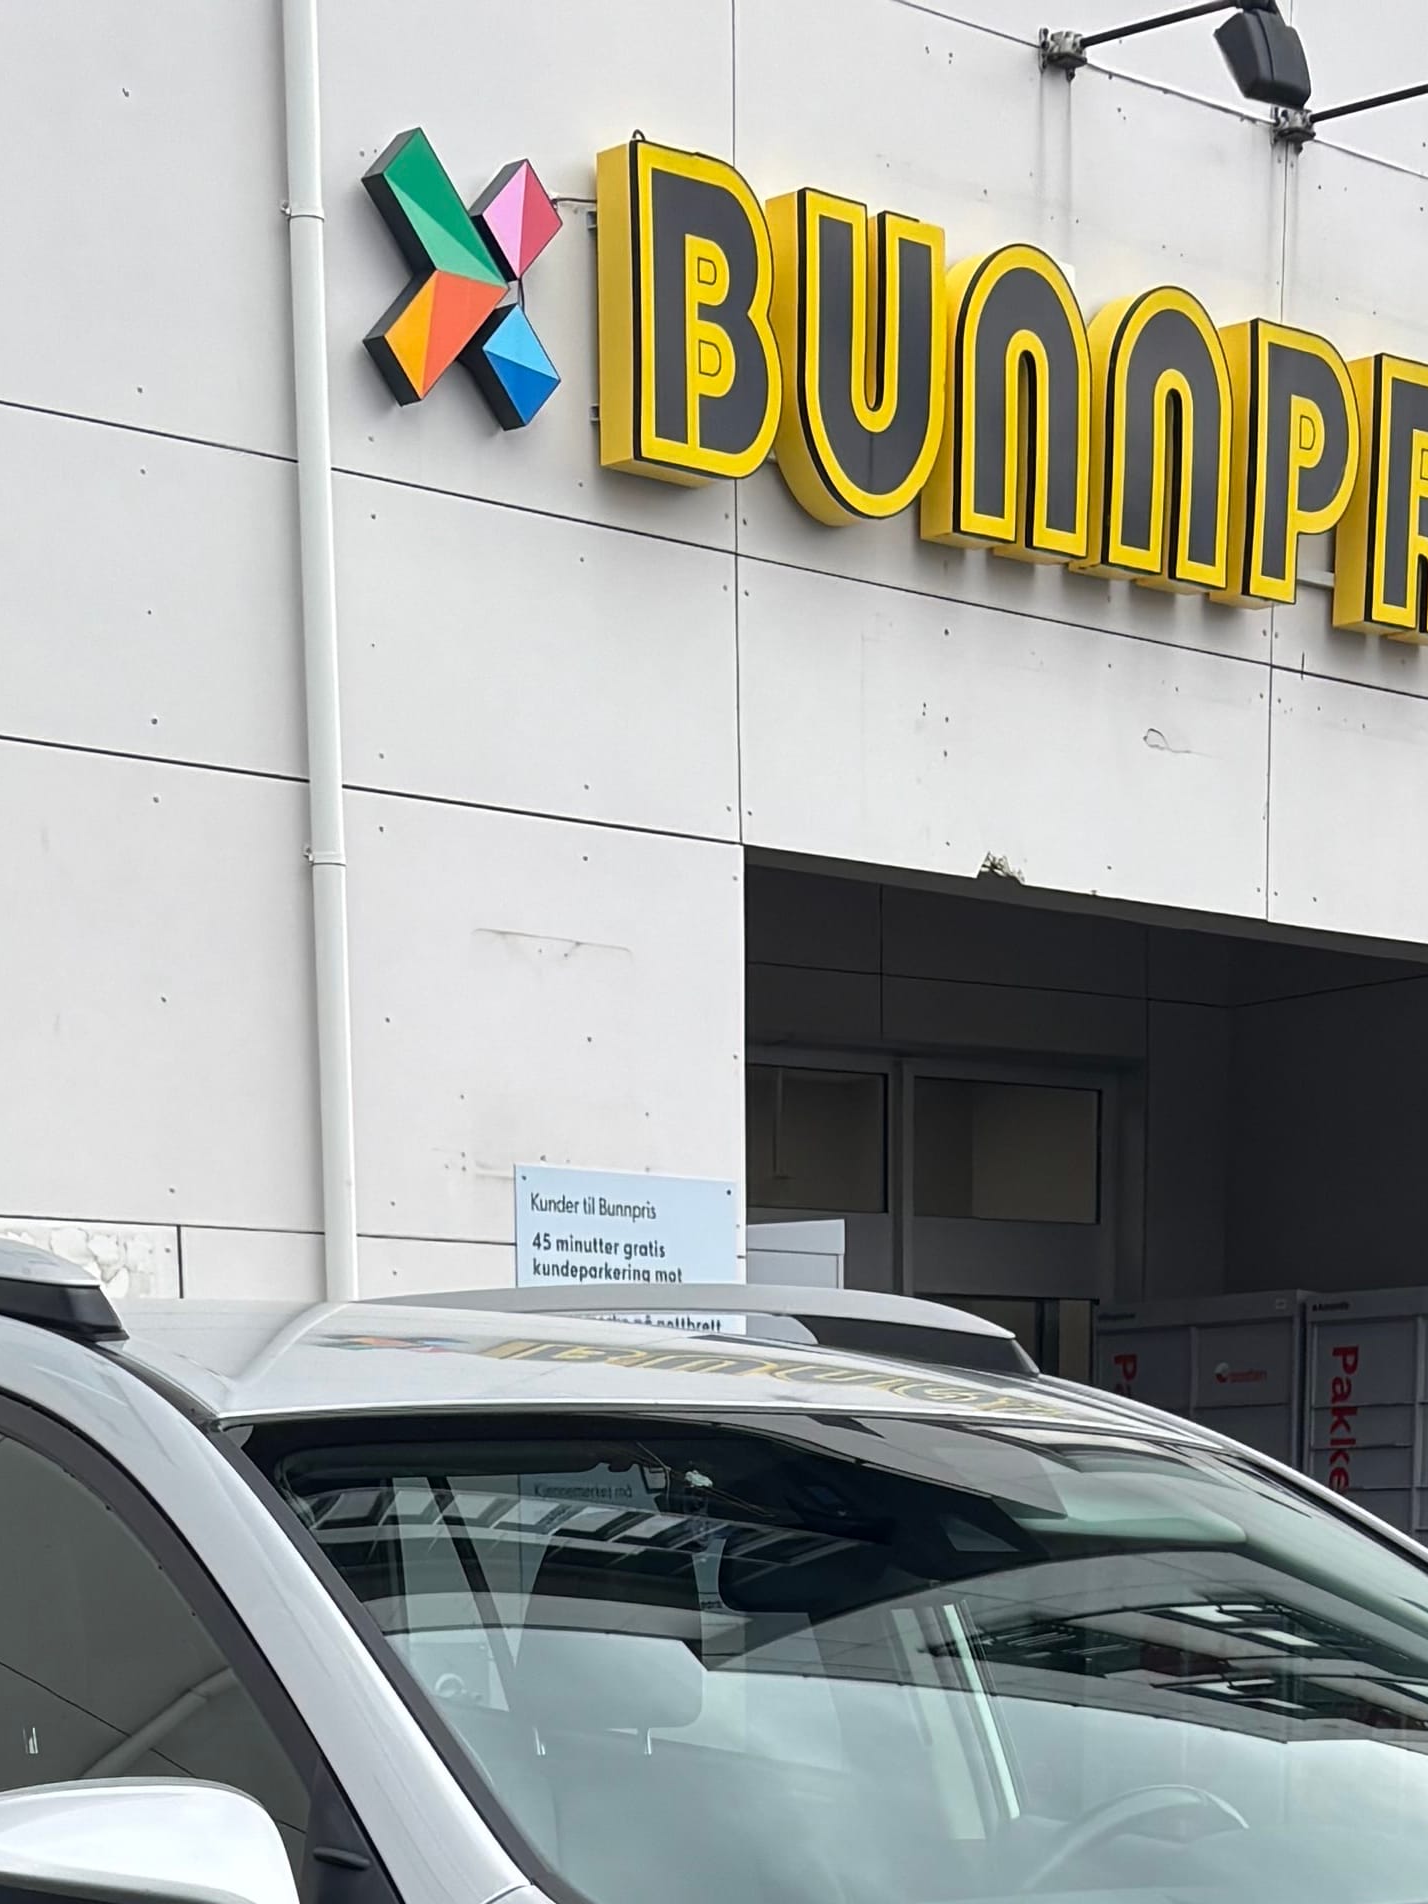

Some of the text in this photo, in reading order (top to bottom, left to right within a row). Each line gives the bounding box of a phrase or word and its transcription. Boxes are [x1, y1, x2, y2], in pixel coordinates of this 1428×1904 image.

[530, 1192, 657, 1223] Kunder til Bunnpris
[532, 1232, 666, 1260] 45 minutter gratis
[533, 1258, 683, 1284] kundeparkering mot
